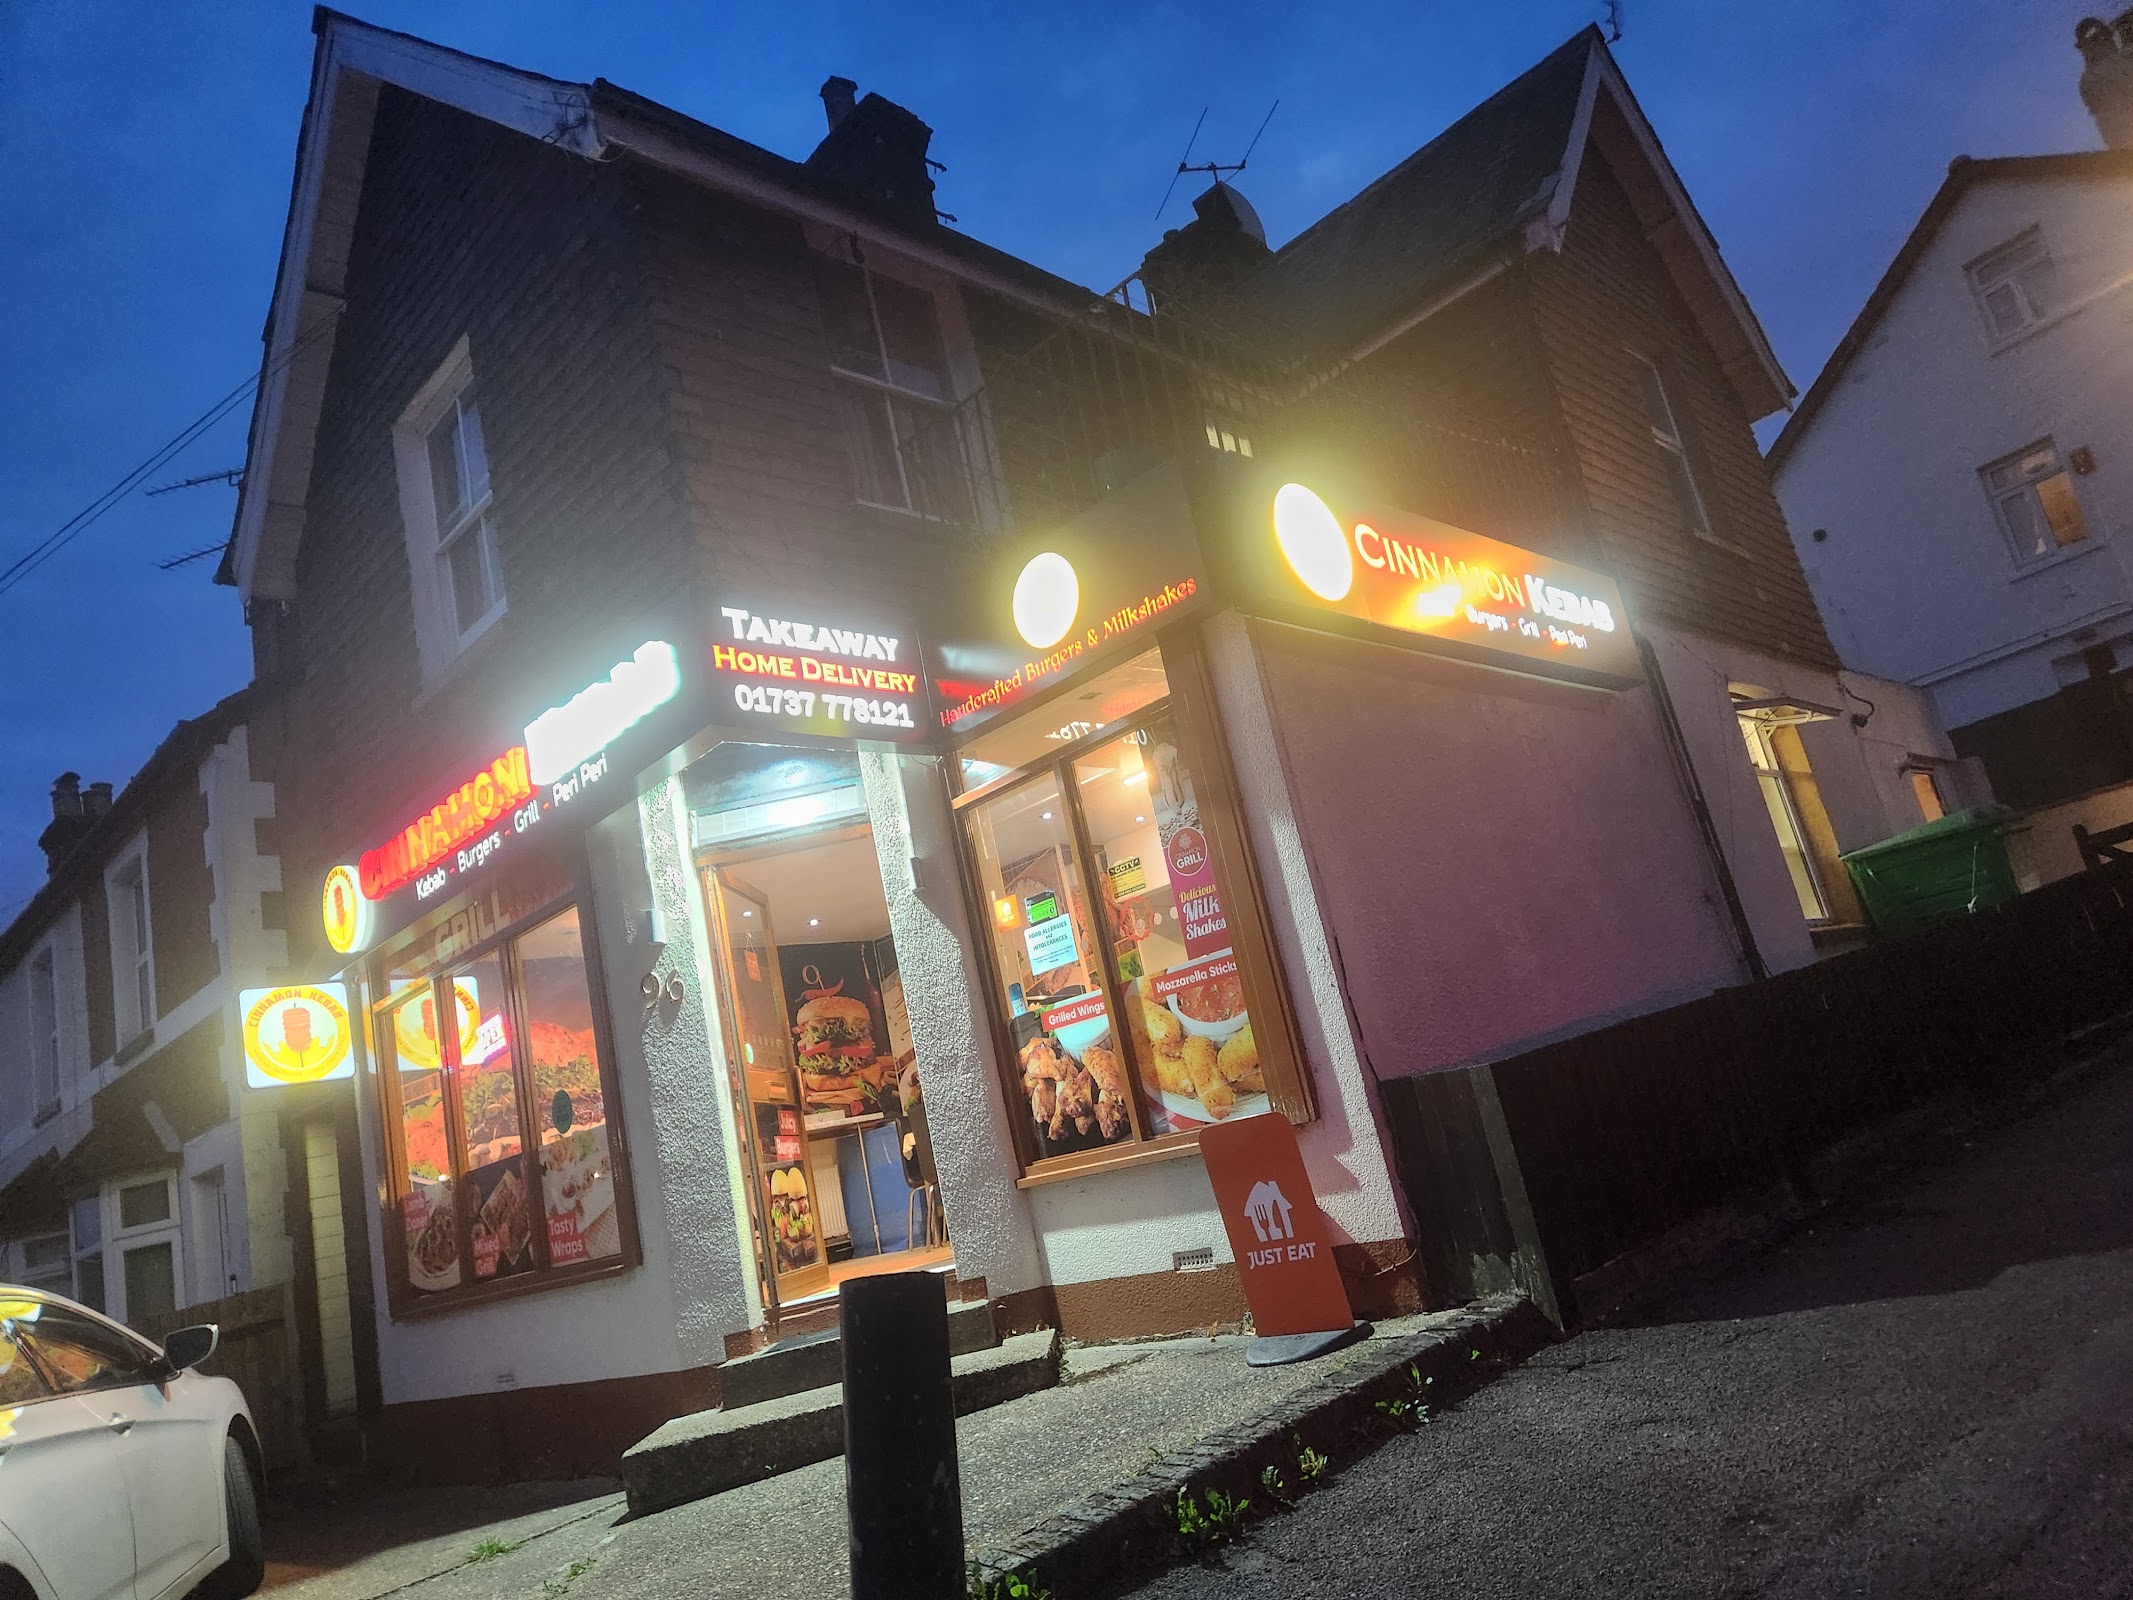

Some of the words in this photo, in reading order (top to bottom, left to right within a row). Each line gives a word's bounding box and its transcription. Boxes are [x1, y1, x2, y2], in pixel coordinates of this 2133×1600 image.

[1354, 523, 1526, 607] CINNAMON
[721, 606, 898, 661] TAKEAWAY
[939, 669, 1022, 728] Handcrafted
[1025, 639, 1083, 683] Burgers
[1086, 627, 1099, 649] &
[1103, 575, 1197, 640] Milkshakes
[712, 644, 797, 678] HOME
[800, 657, 917, 693] DELIVERY
[734, 683, 816, 718] 01737
[821, 693, 915, 729] 778121
[416, 866, 446, 901] Kebab
[457, 831, 500, 873] Burgers
[513, 798, 541, 834] Grill
[552, 772, 579, 807] Peri
[579, 751, 608, 788] Peri
[1114, 860, 1135, 874] CCTV
[1176, 851, 1203, 869] GRILL
[1179, 883, 1216, 903] Delicious
[1183, 895, 1220, 923] Milk
[1028, 931, 1042, 940] FOOD
[1042, 920, 1067, 935] ALLERGIES
[1186, 917, 1227, 941] Shakes
[1033, 933, 1068, 951] INTOLERANCES
[641, 969, 684, 1010] 96
[1155, 970, 1208, 993] Mozzarella
[249, 989, 302, 1027] CINNAMON
[309, 991, 344, 1020] KEBAB
[1048, 1008, 1077, 1026] Grilled
[1077, 1001, 1105, 1018] Wings
[775, 1137, 801, 1159] Burgers
[548, 1218, 576, 1239] Tasty
[474, 1235, 499, 1254] Mixed
[551, 1238, 584, 1259] Wraps
[1247, 1247, 1283, 1270] JUST
[1288, 1242, 1317, 1261] EAT
[477, 1256, 498, 1276] Grill
